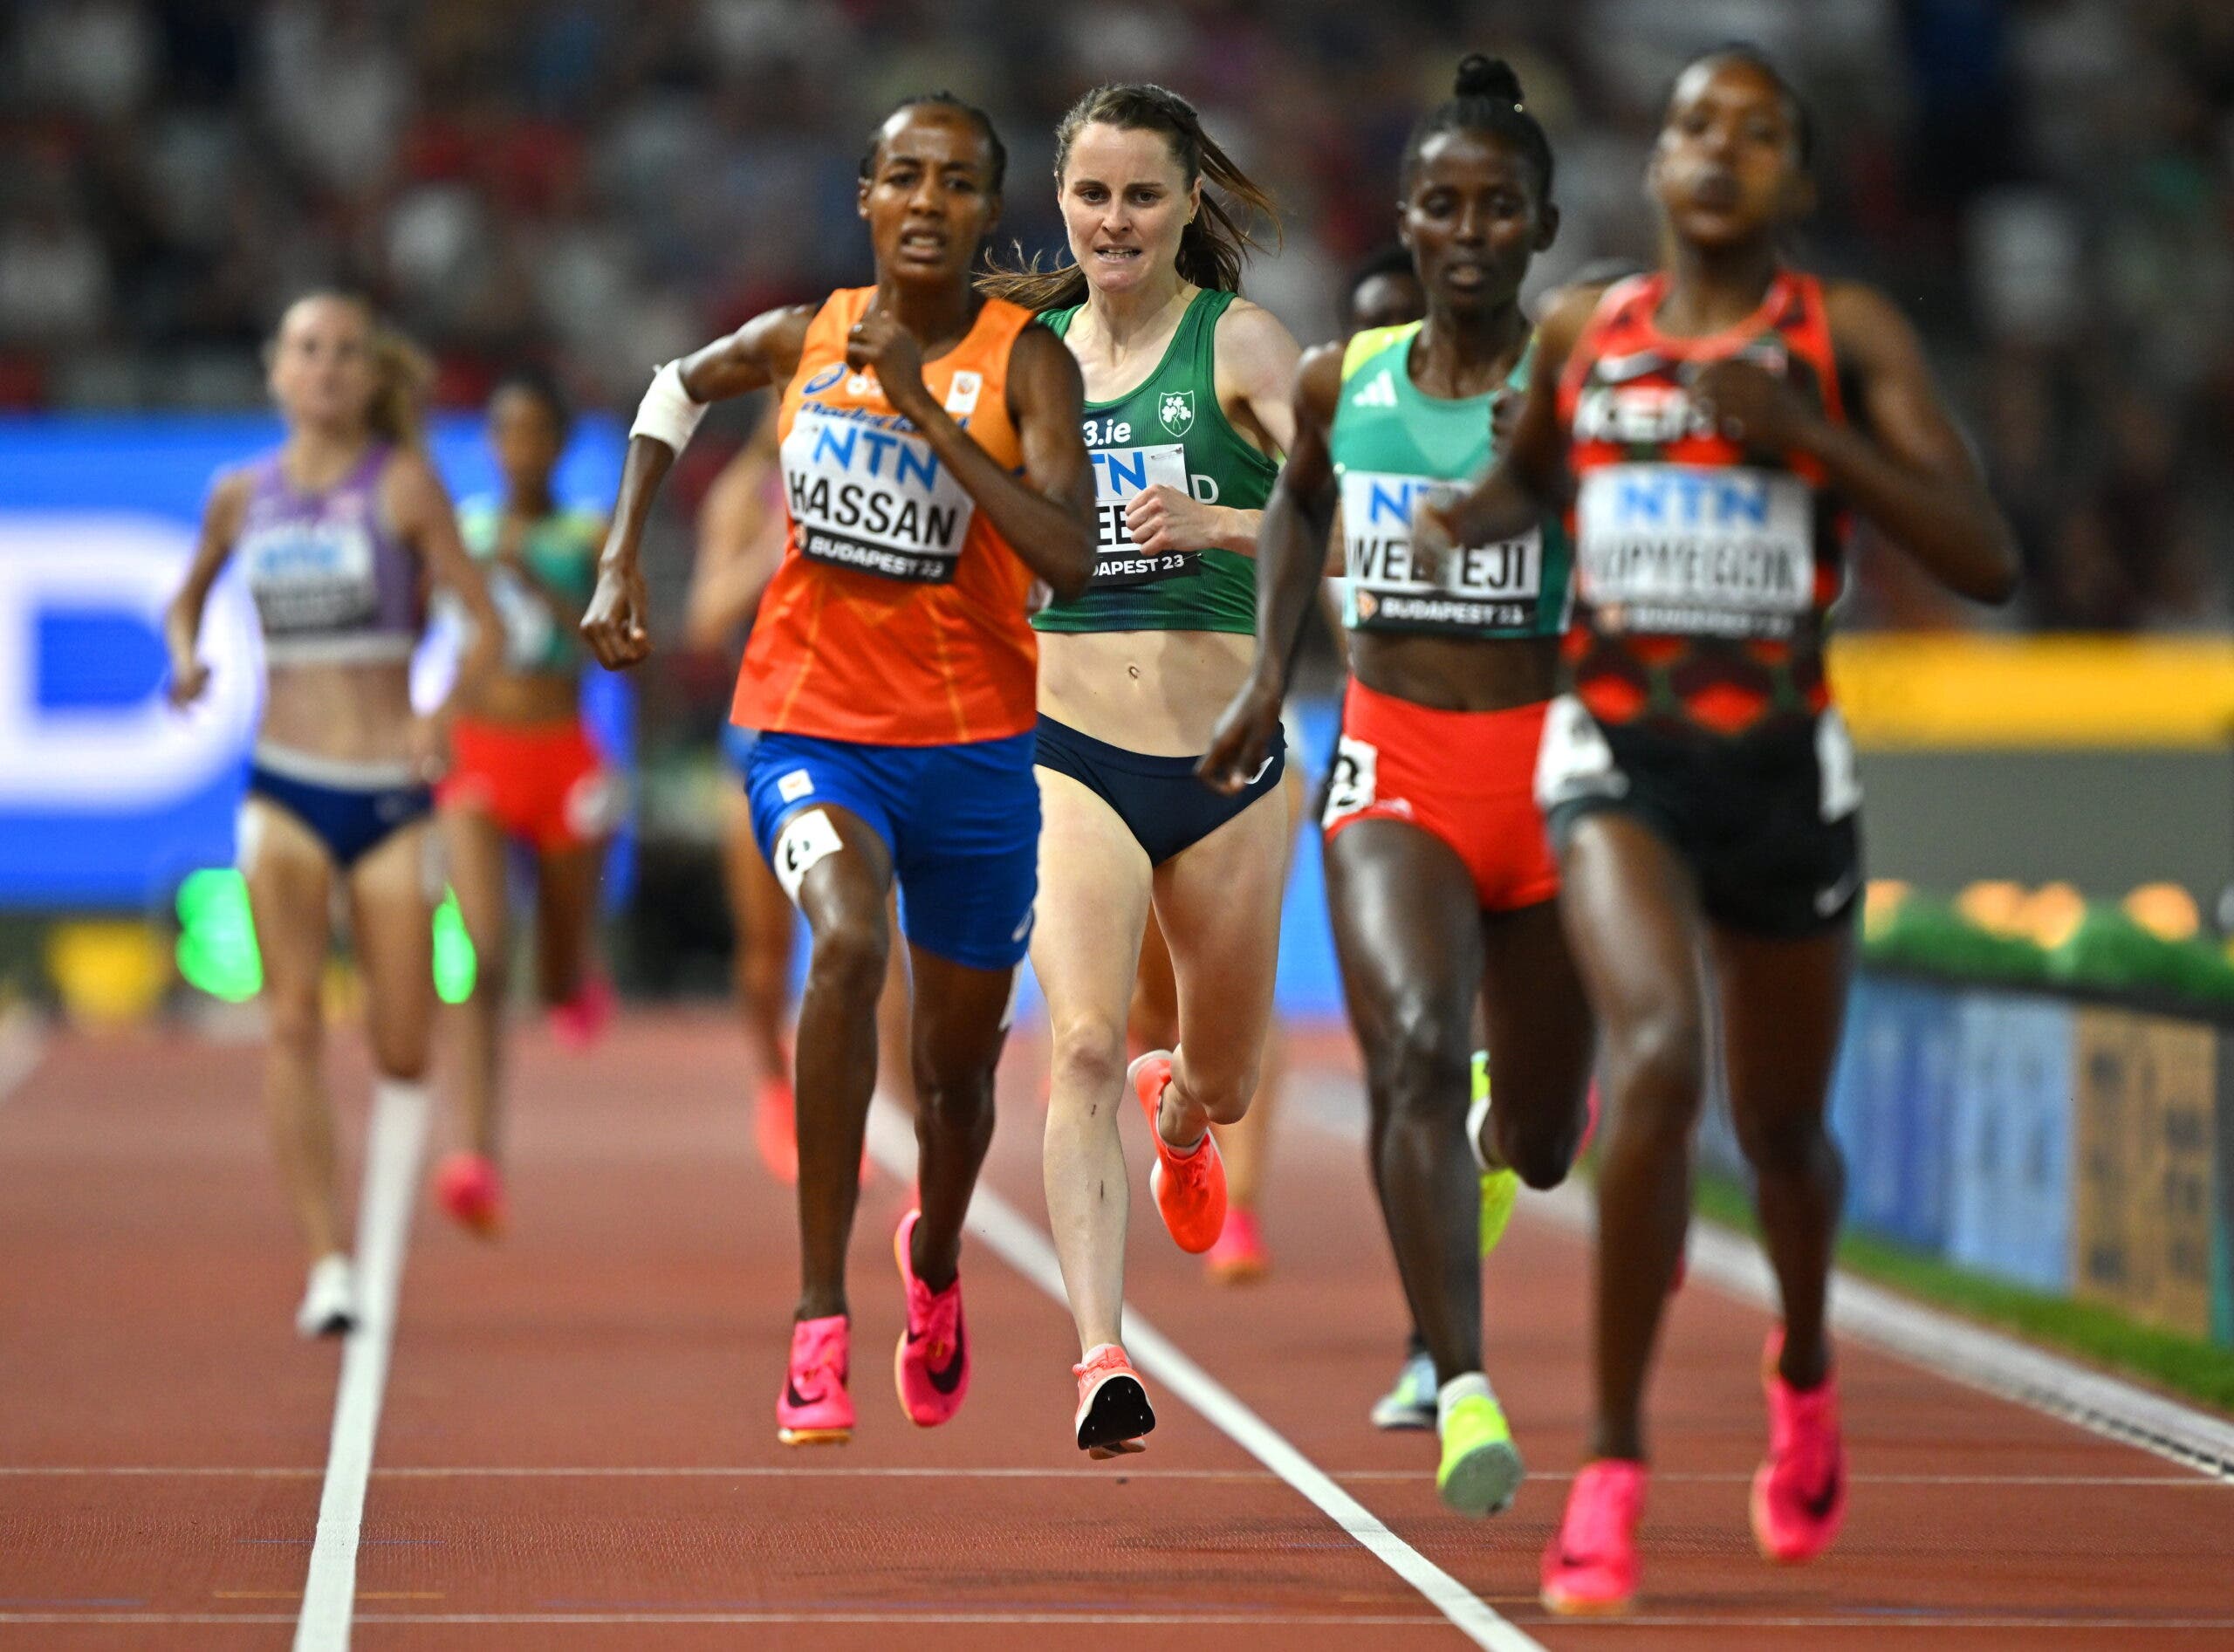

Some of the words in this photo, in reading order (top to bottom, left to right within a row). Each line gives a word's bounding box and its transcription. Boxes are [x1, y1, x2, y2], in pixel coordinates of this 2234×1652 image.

[1083, 419, 1131, 447] 3.ie
[812, 425, 940, 494] NTN
[789, 470, 957, 548] HASSAN
[1616, 476, 1767, 524] NTN
[808, 535, 915, 577] BUDAPEST
[919, 559, 945, 579] 23
[1162, 554, 1185, 570] 23
[1353, 535, 1525, 589] WEEJI
[1381, 597, 1493, 624] BUDAPEST
